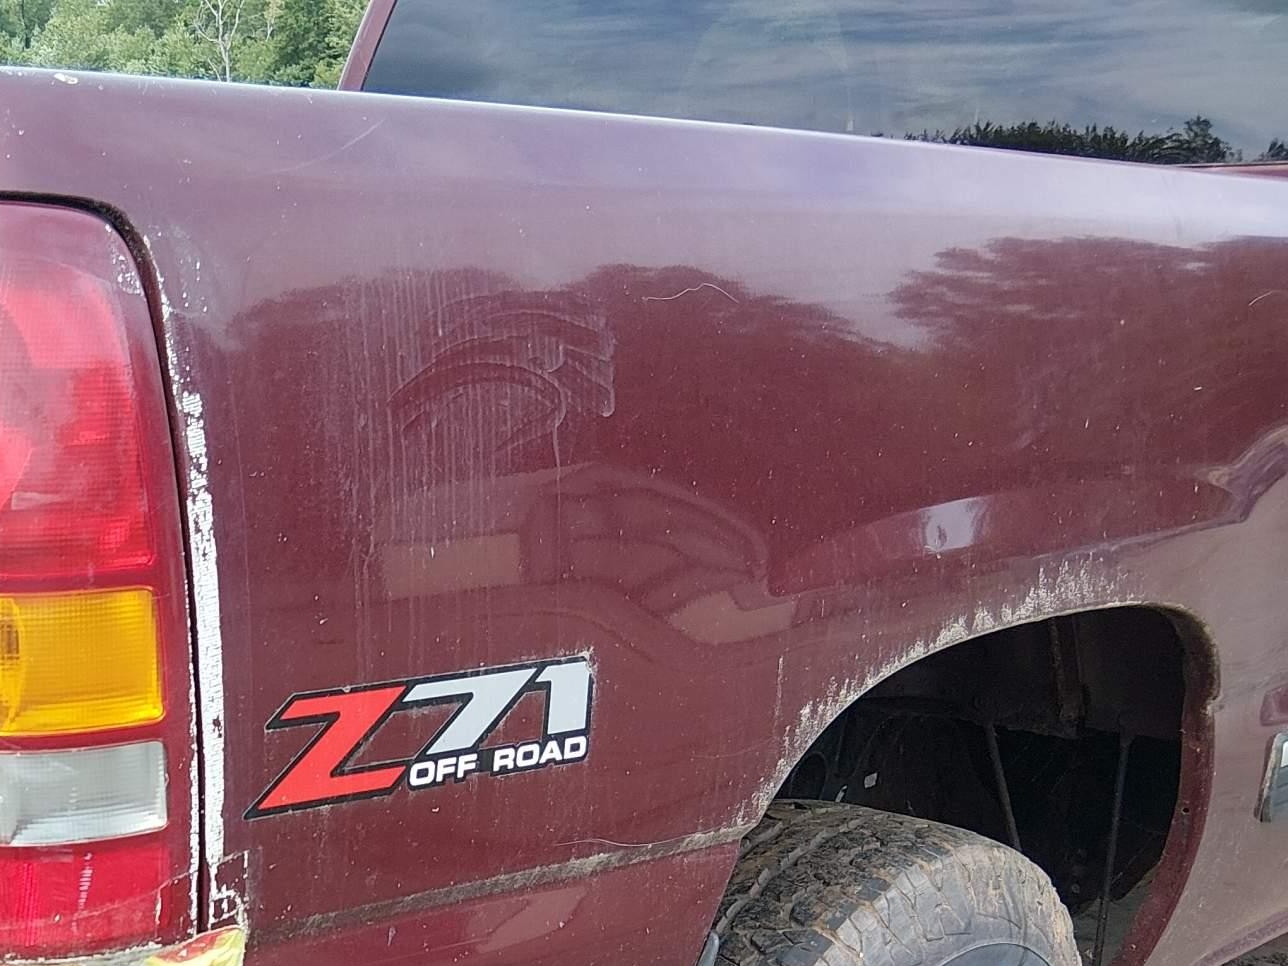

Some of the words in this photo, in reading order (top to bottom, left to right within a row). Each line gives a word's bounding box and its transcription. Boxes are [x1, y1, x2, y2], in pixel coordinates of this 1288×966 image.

[255, 659, 592, 812] Z71
[409, 754, 479, 787] OFF
[492, 735, 588, 773] ROAD
